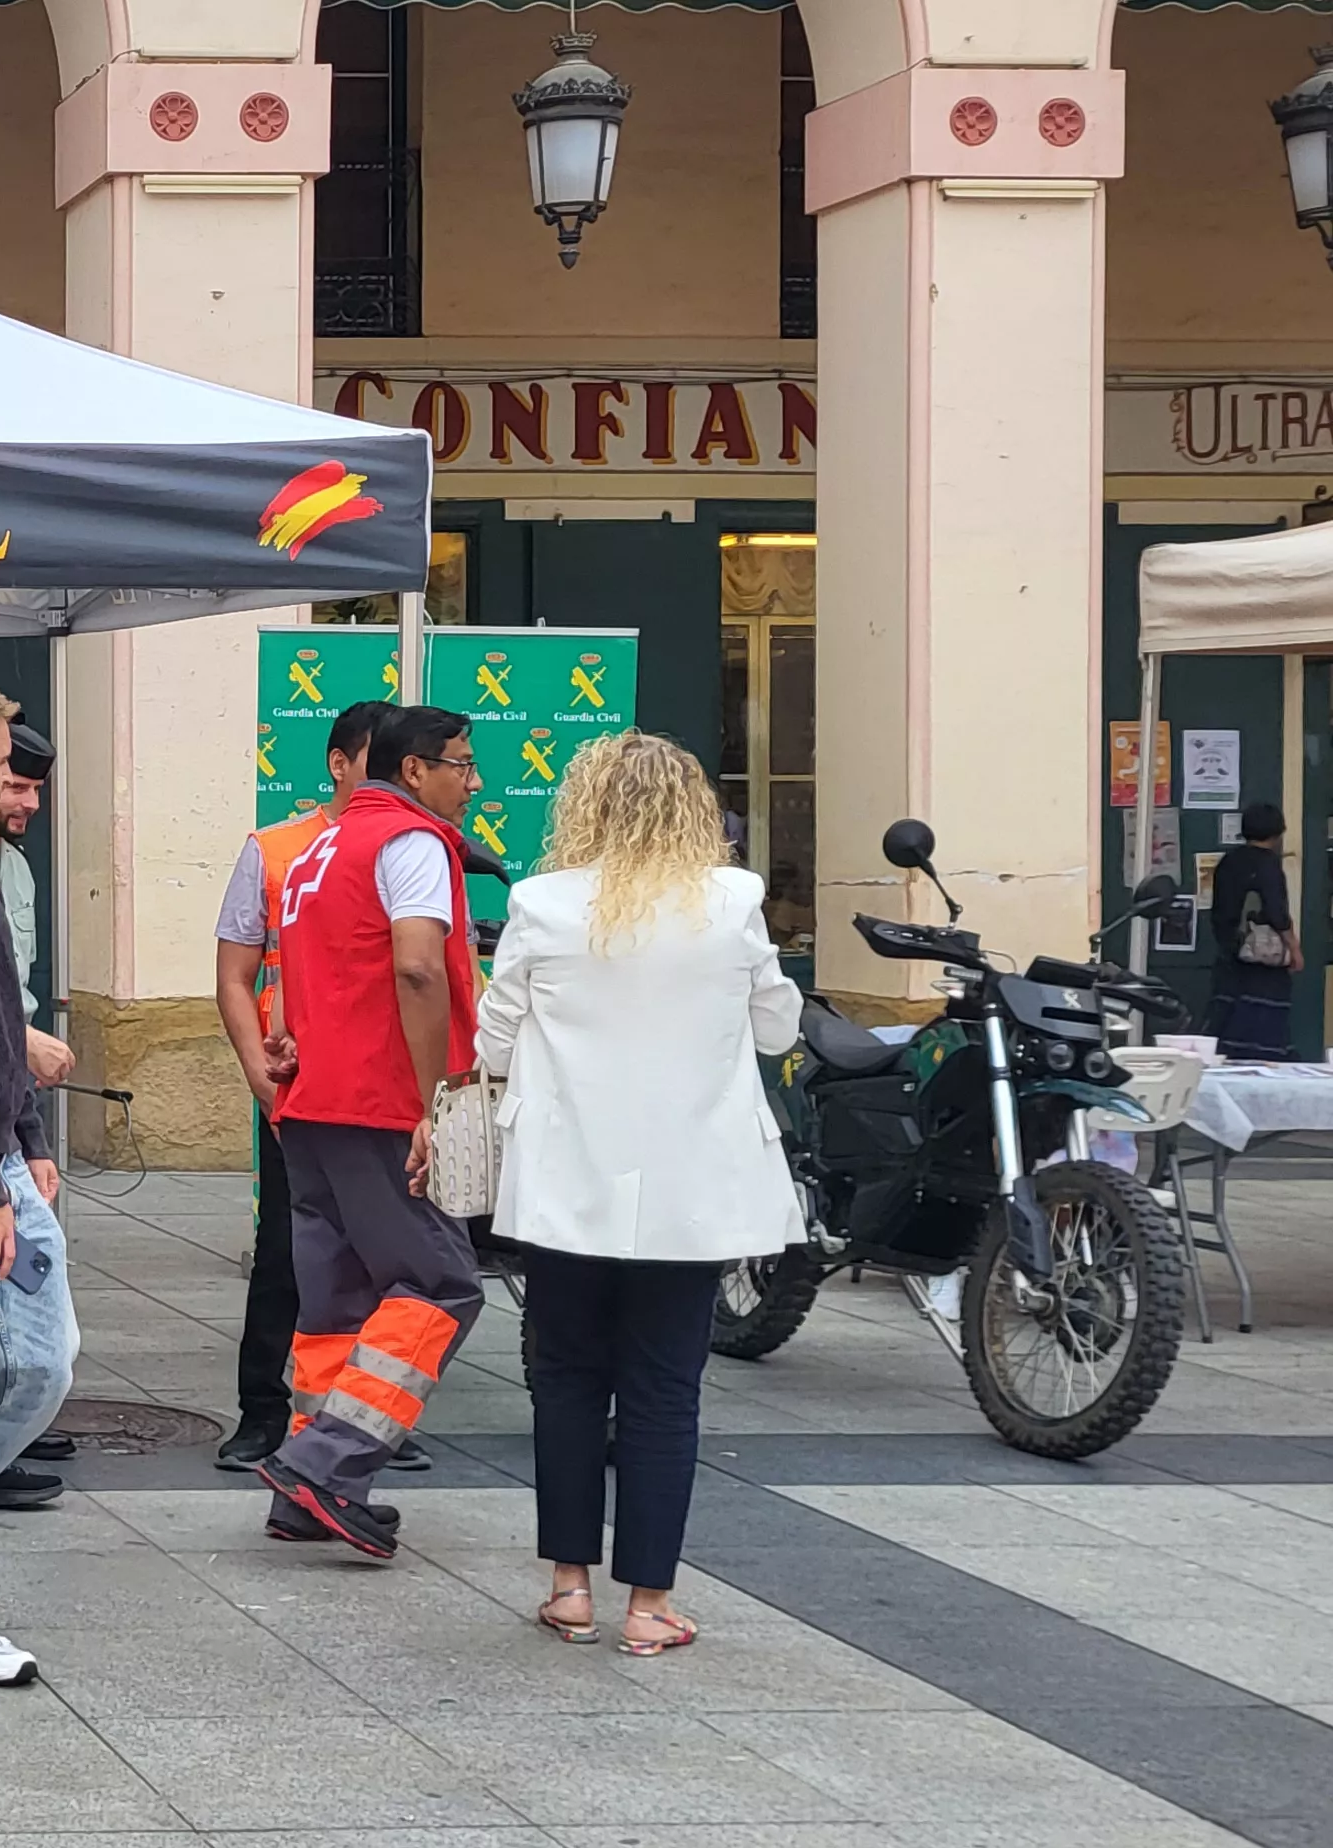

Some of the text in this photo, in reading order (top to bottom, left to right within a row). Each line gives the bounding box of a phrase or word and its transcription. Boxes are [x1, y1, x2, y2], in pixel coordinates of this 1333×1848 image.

[1185, 384, 1333, 459] ULTRA
[273, 707, 339, 718] Guardia Civil
[503, 711, 527, 721] Civil
[553, 711, 621, 723] Guardia Civil
[268, 782, 293, 792] Civil
[505, 786, 545, 796] Guardia
